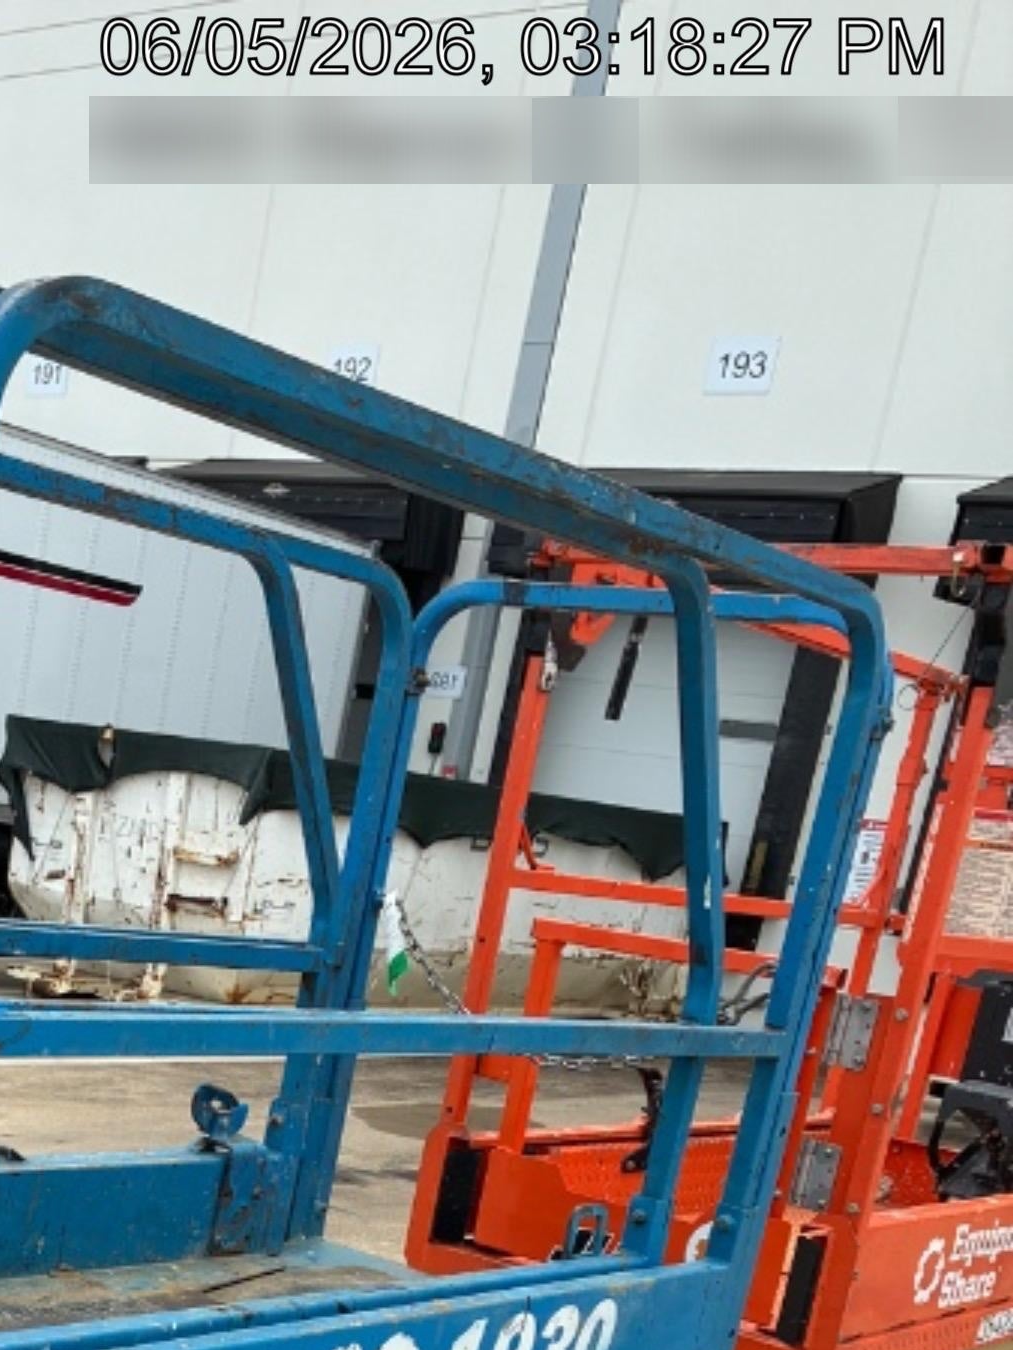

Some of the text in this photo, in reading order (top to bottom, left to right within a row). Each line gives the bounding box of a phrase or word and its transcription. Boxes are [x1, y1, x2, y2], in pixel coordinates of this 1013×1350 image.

[34, 362, 62, 385] 191
[333, 355, 372, 382] 192
[718, 350, 768, 379] 193
[938, 1268, 998, 1309] Share
